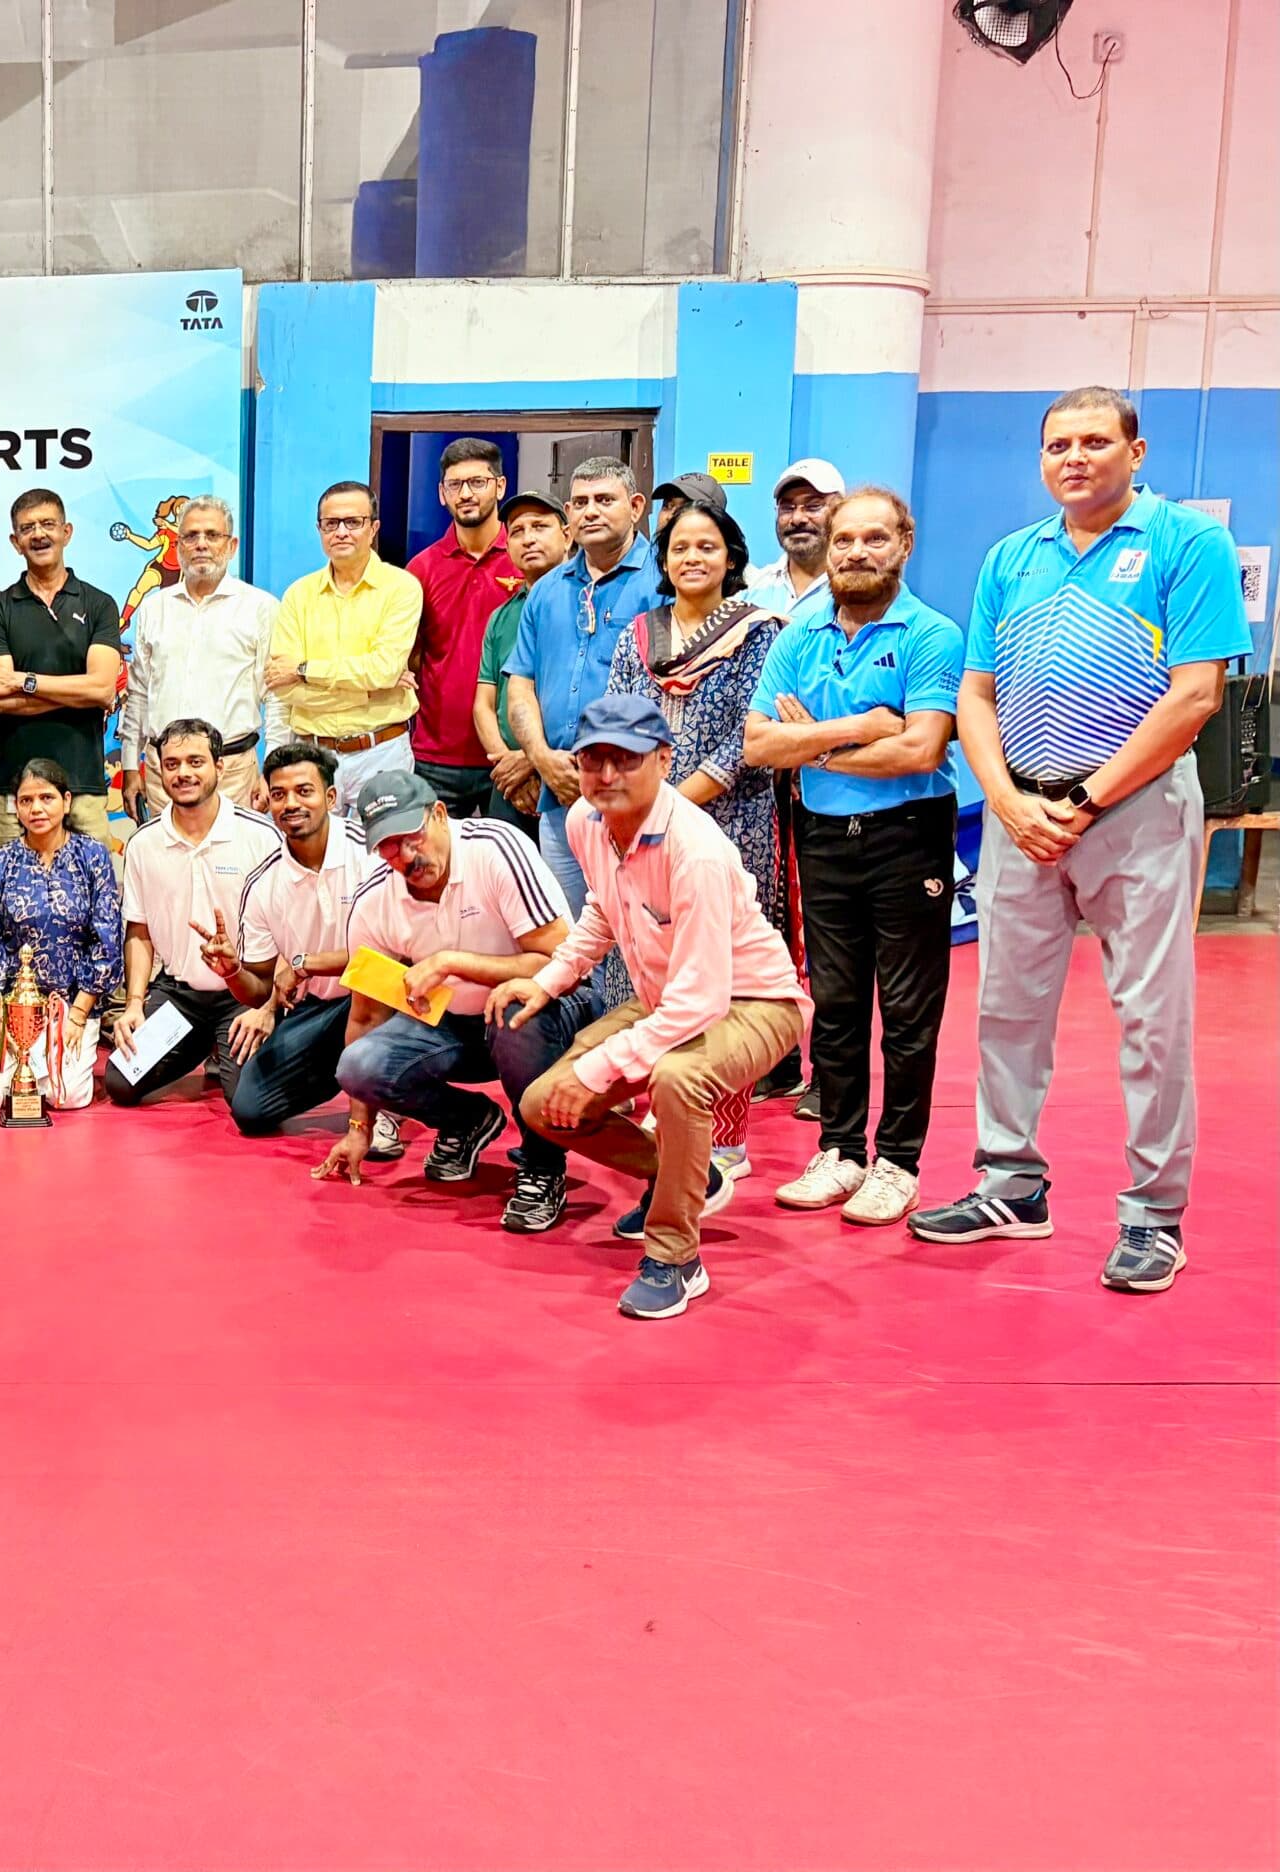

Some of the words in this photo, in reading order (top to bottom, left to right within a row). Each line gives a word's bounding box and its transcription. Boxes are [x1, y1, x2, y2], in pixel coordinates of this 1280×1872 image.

[180, 317, 223, 330] TATA
[712, 458, 749, 467] TABLE
[727, 469, 733, 478] 3
